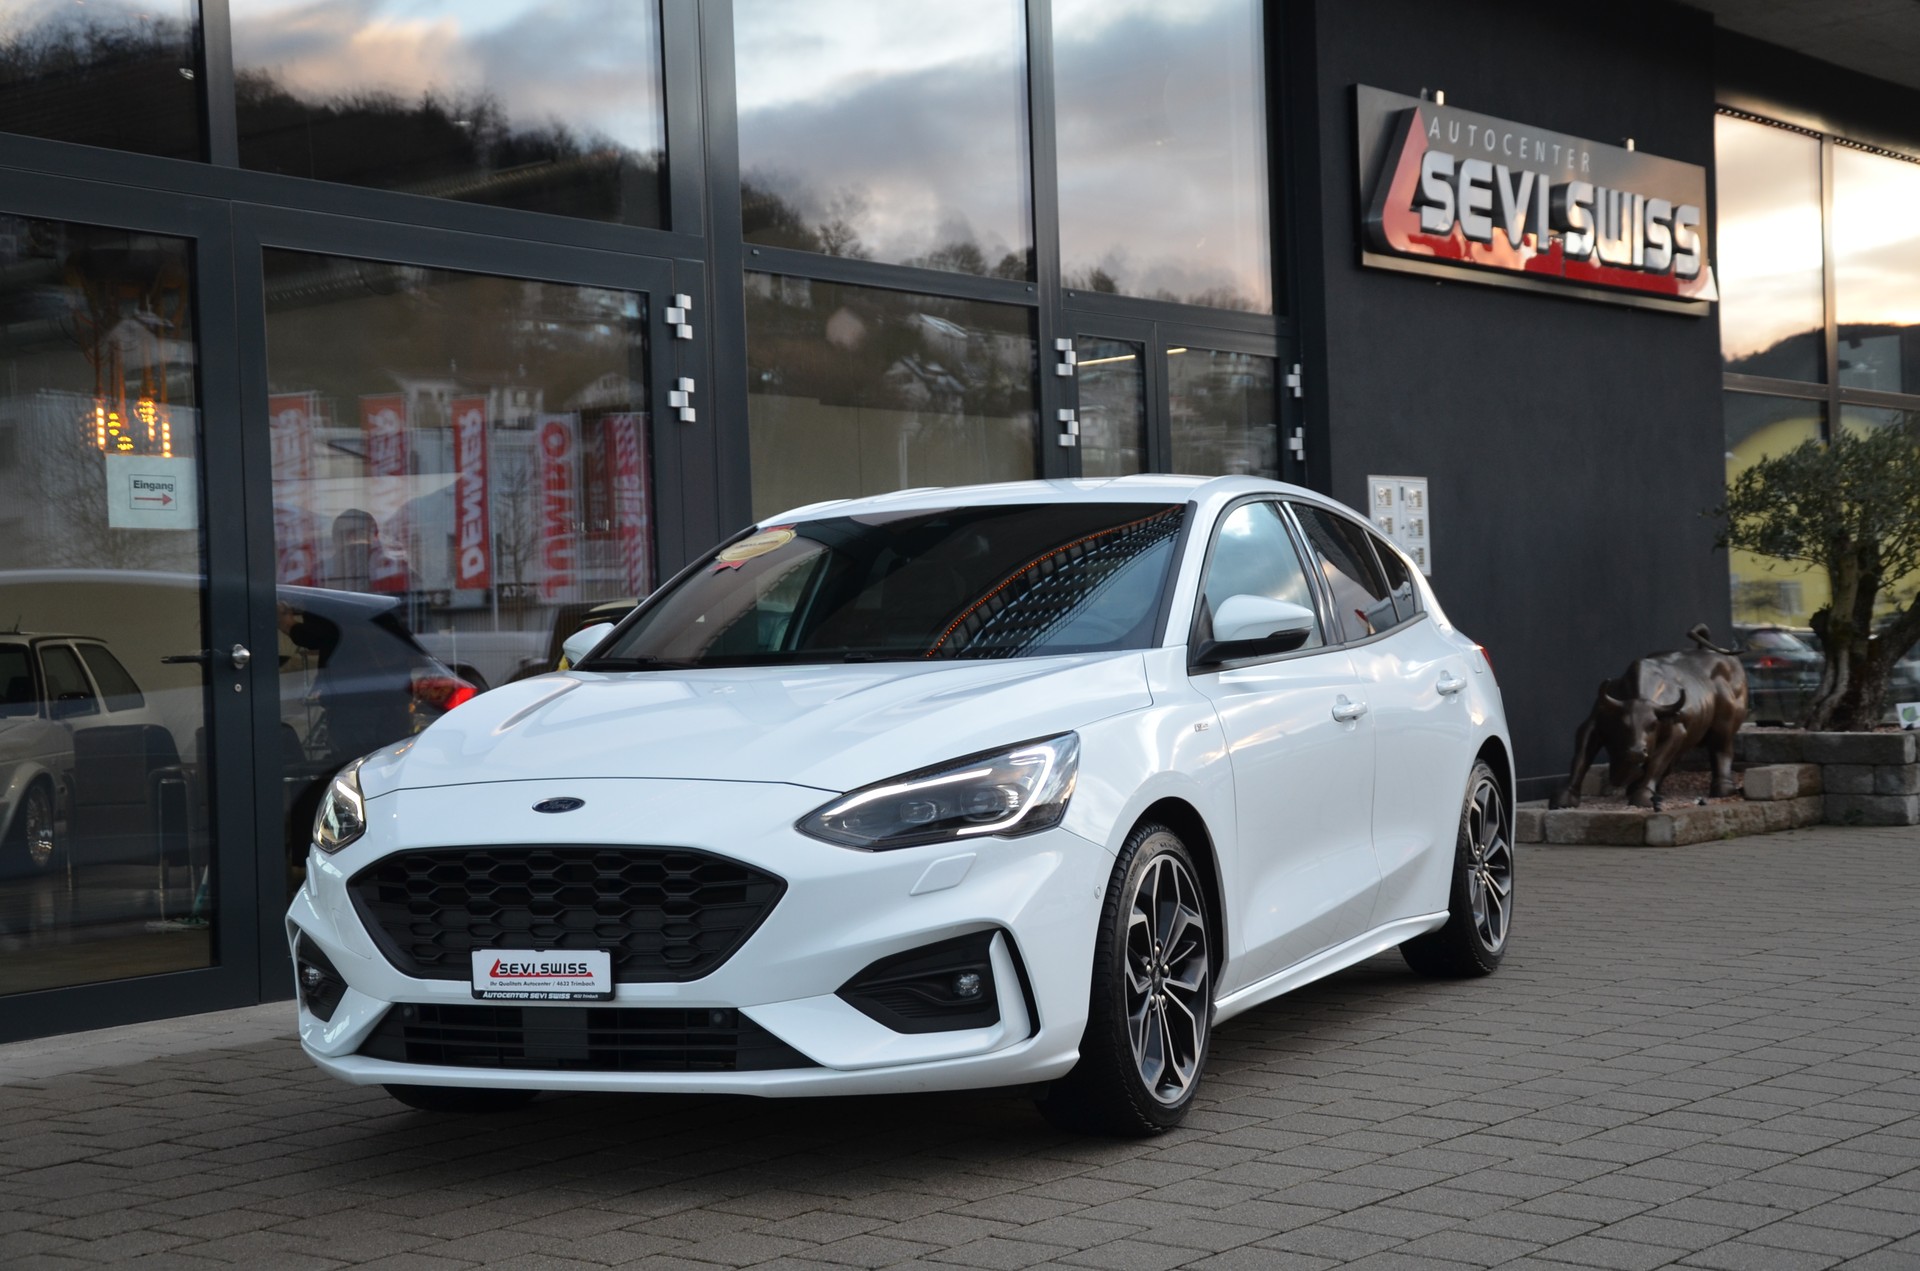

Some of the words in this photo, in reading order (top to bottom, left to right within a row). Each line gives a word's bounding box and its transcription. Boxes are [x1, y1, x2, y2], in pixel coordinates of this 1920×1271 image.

[1428, 116, 1591, 173] AUTOCENTER
[1420, 150, 1550, 252] SEVI
[1564, 180, 1701, 282] SWISS
[133, 480, 174, 492] Eingang
[499, 963, 536, 975] SEVI
[540, 963, 588, 975] SWISS
